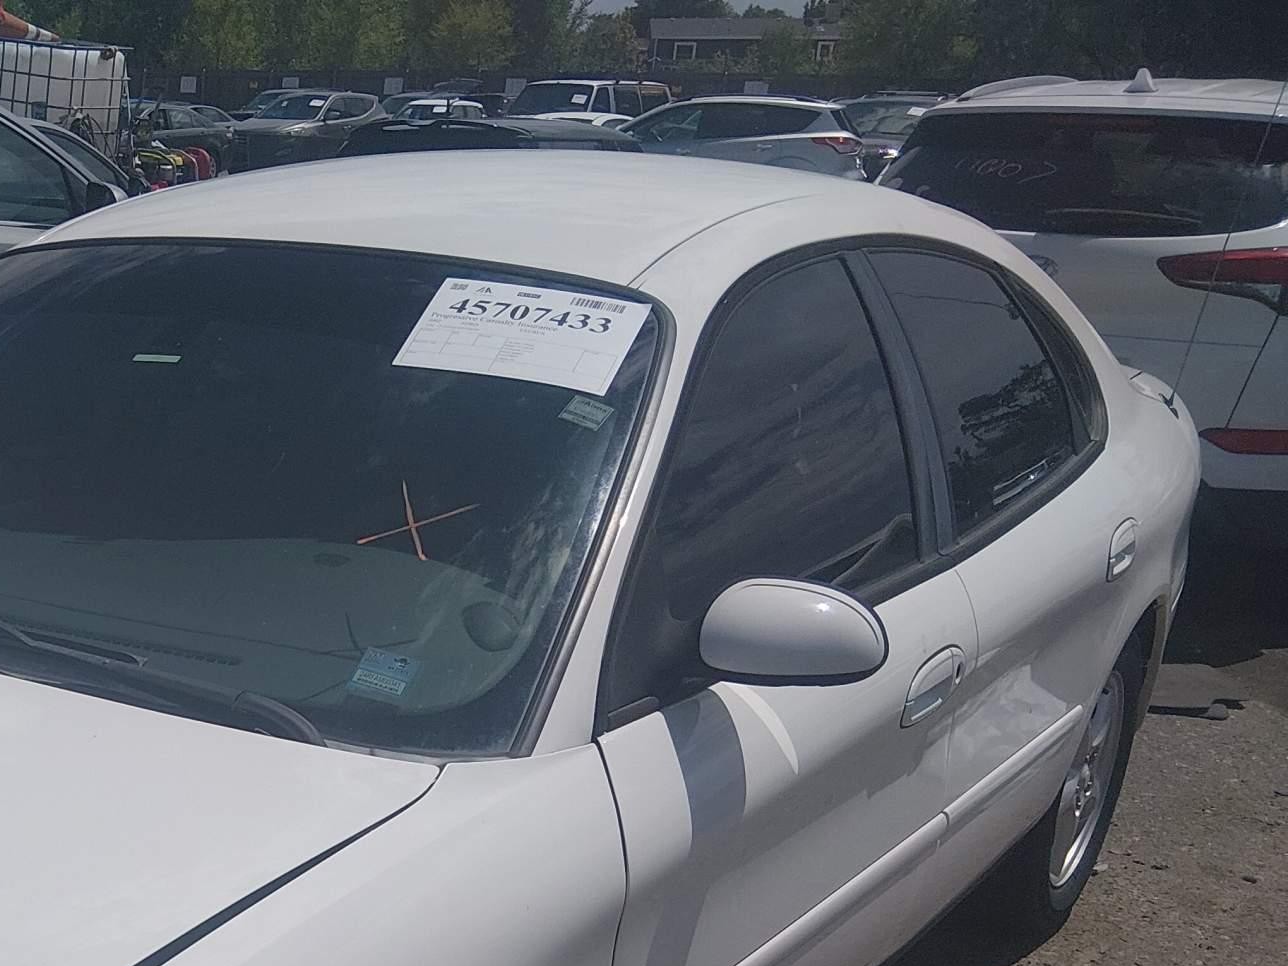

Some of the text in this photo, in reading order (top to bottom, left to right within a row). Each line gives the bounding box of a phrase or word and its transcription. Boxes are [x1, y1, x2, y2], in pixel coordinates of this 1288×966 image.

[431, 311, 480, 322] Progressive
[480, 316, 516, 327] Casualty
[517, 320, 559, 332] Insurance
[449, 298, 613, 334] 45707433
